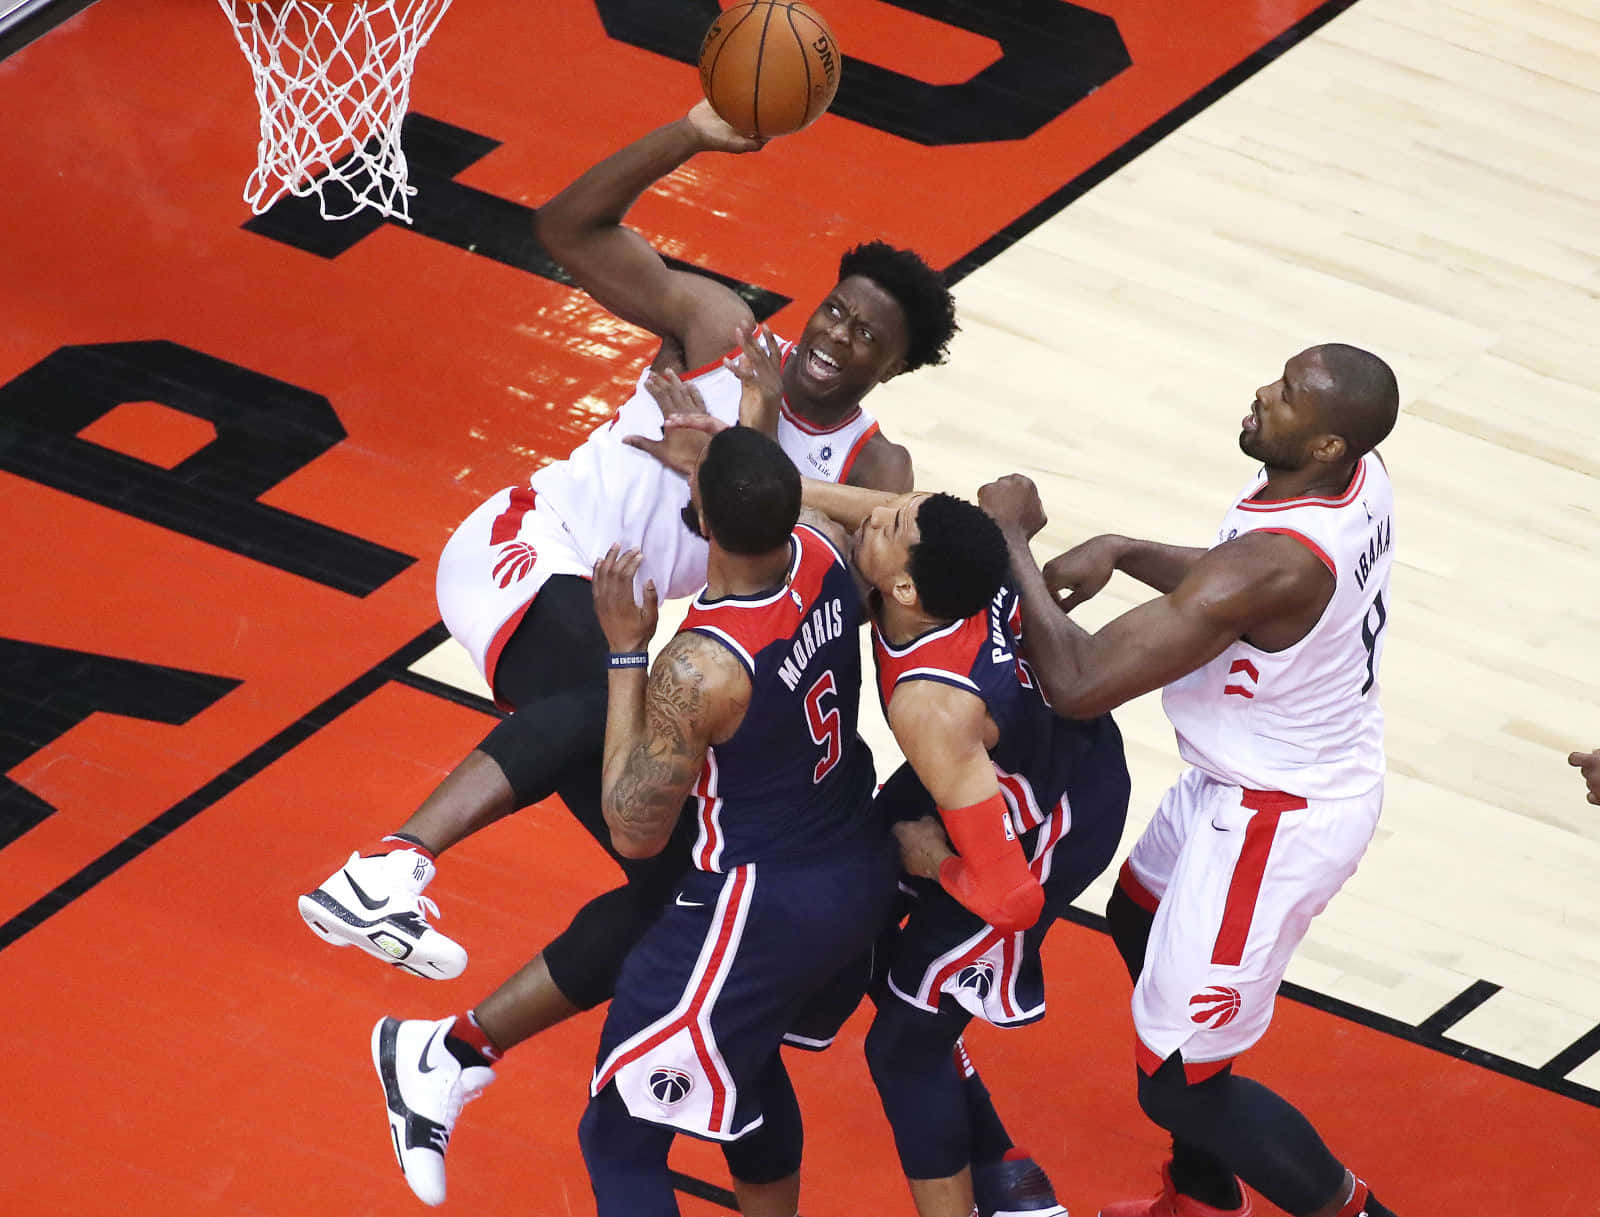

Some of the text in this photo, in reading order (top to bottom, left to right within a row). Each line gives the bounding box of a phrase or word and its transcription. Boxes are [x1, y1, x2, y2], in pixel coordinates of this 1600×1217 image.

[807, 453, 831, 477] Sun Life
[1355, 515, 1391, 592] IBAKA
[778, 598, 842, 692] MORRIS
[1361, 590, 1386, 696] 9
[804, 669, 842, 785] 5
